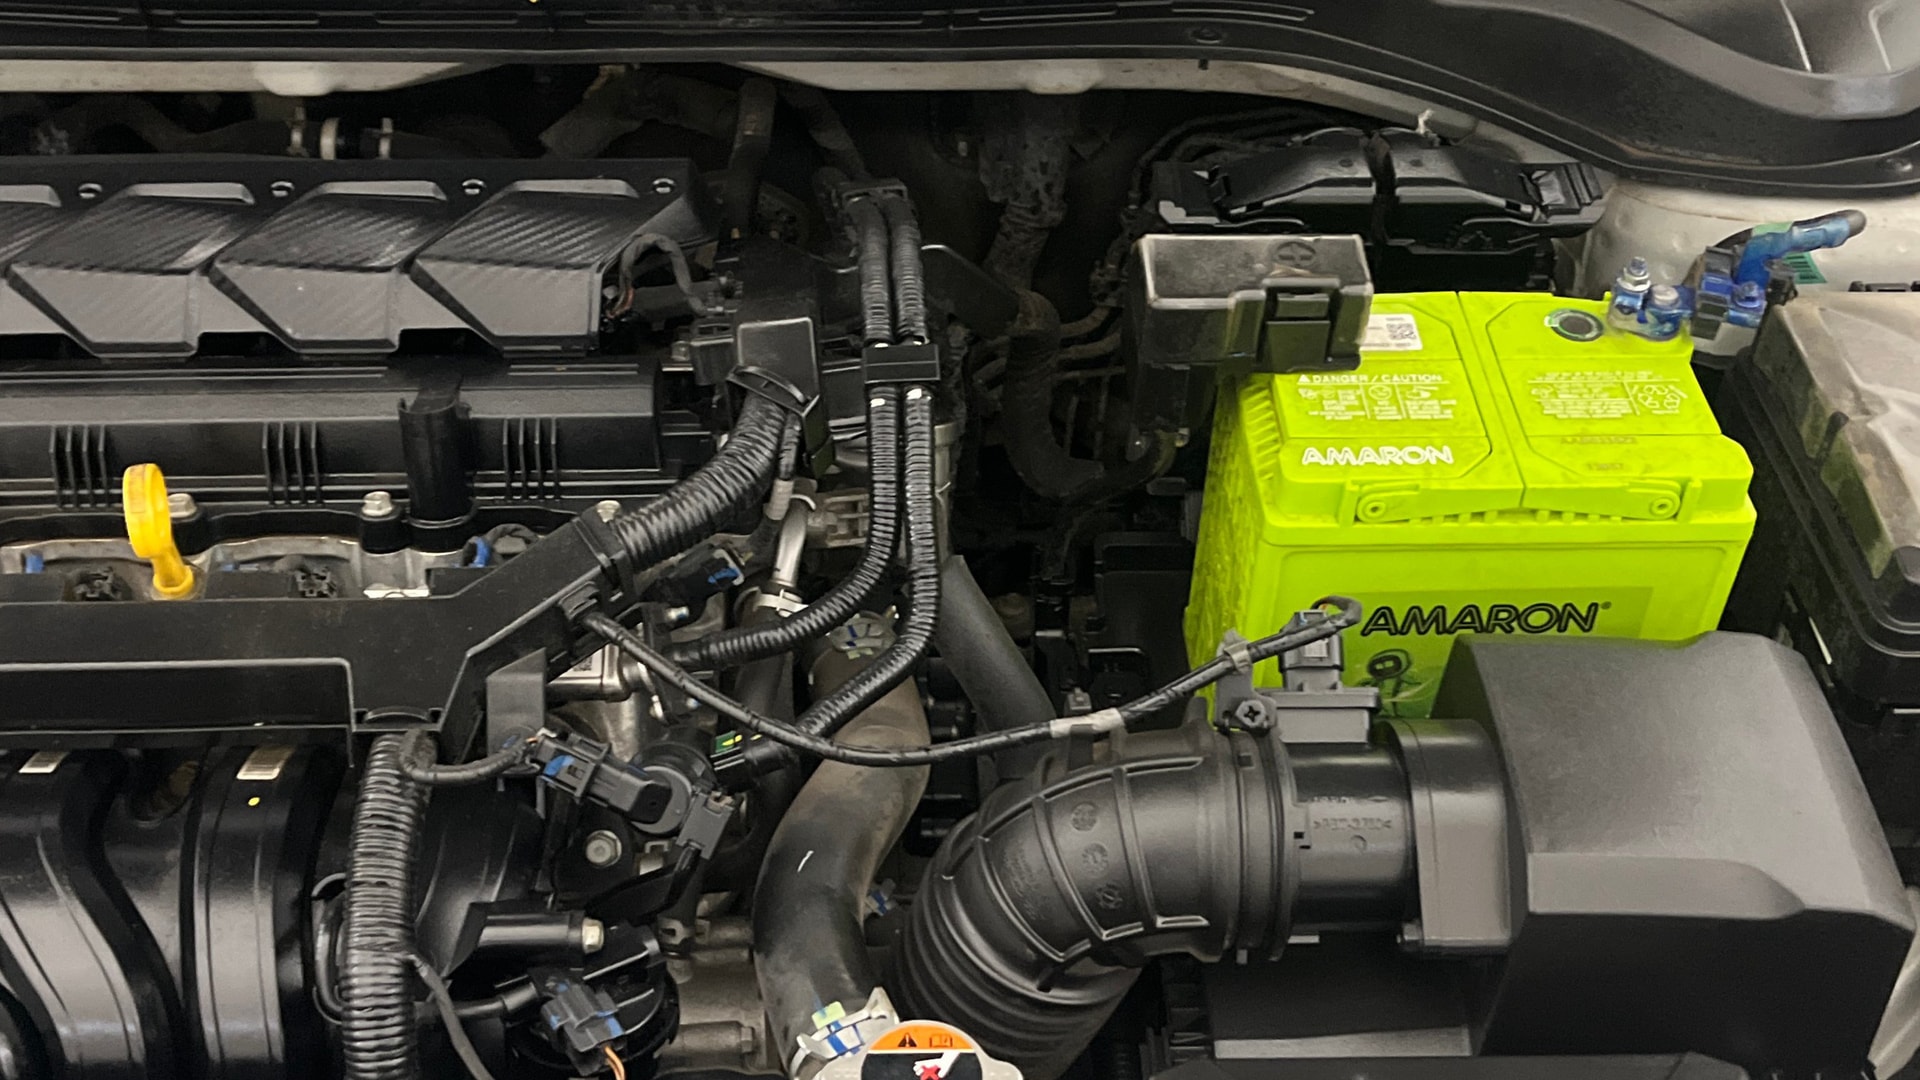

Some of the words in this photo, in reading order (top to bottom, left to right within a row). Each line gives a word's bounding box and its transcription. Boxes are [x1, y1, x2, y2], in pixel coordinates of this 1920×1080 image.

[1312, 374, 1368, 383] DANGER
[1381, 374, 1442, 382] CAUTION
[1302, 445, 1454, 465] AMARON
[1360, 602, 1600, 636] AMARON
